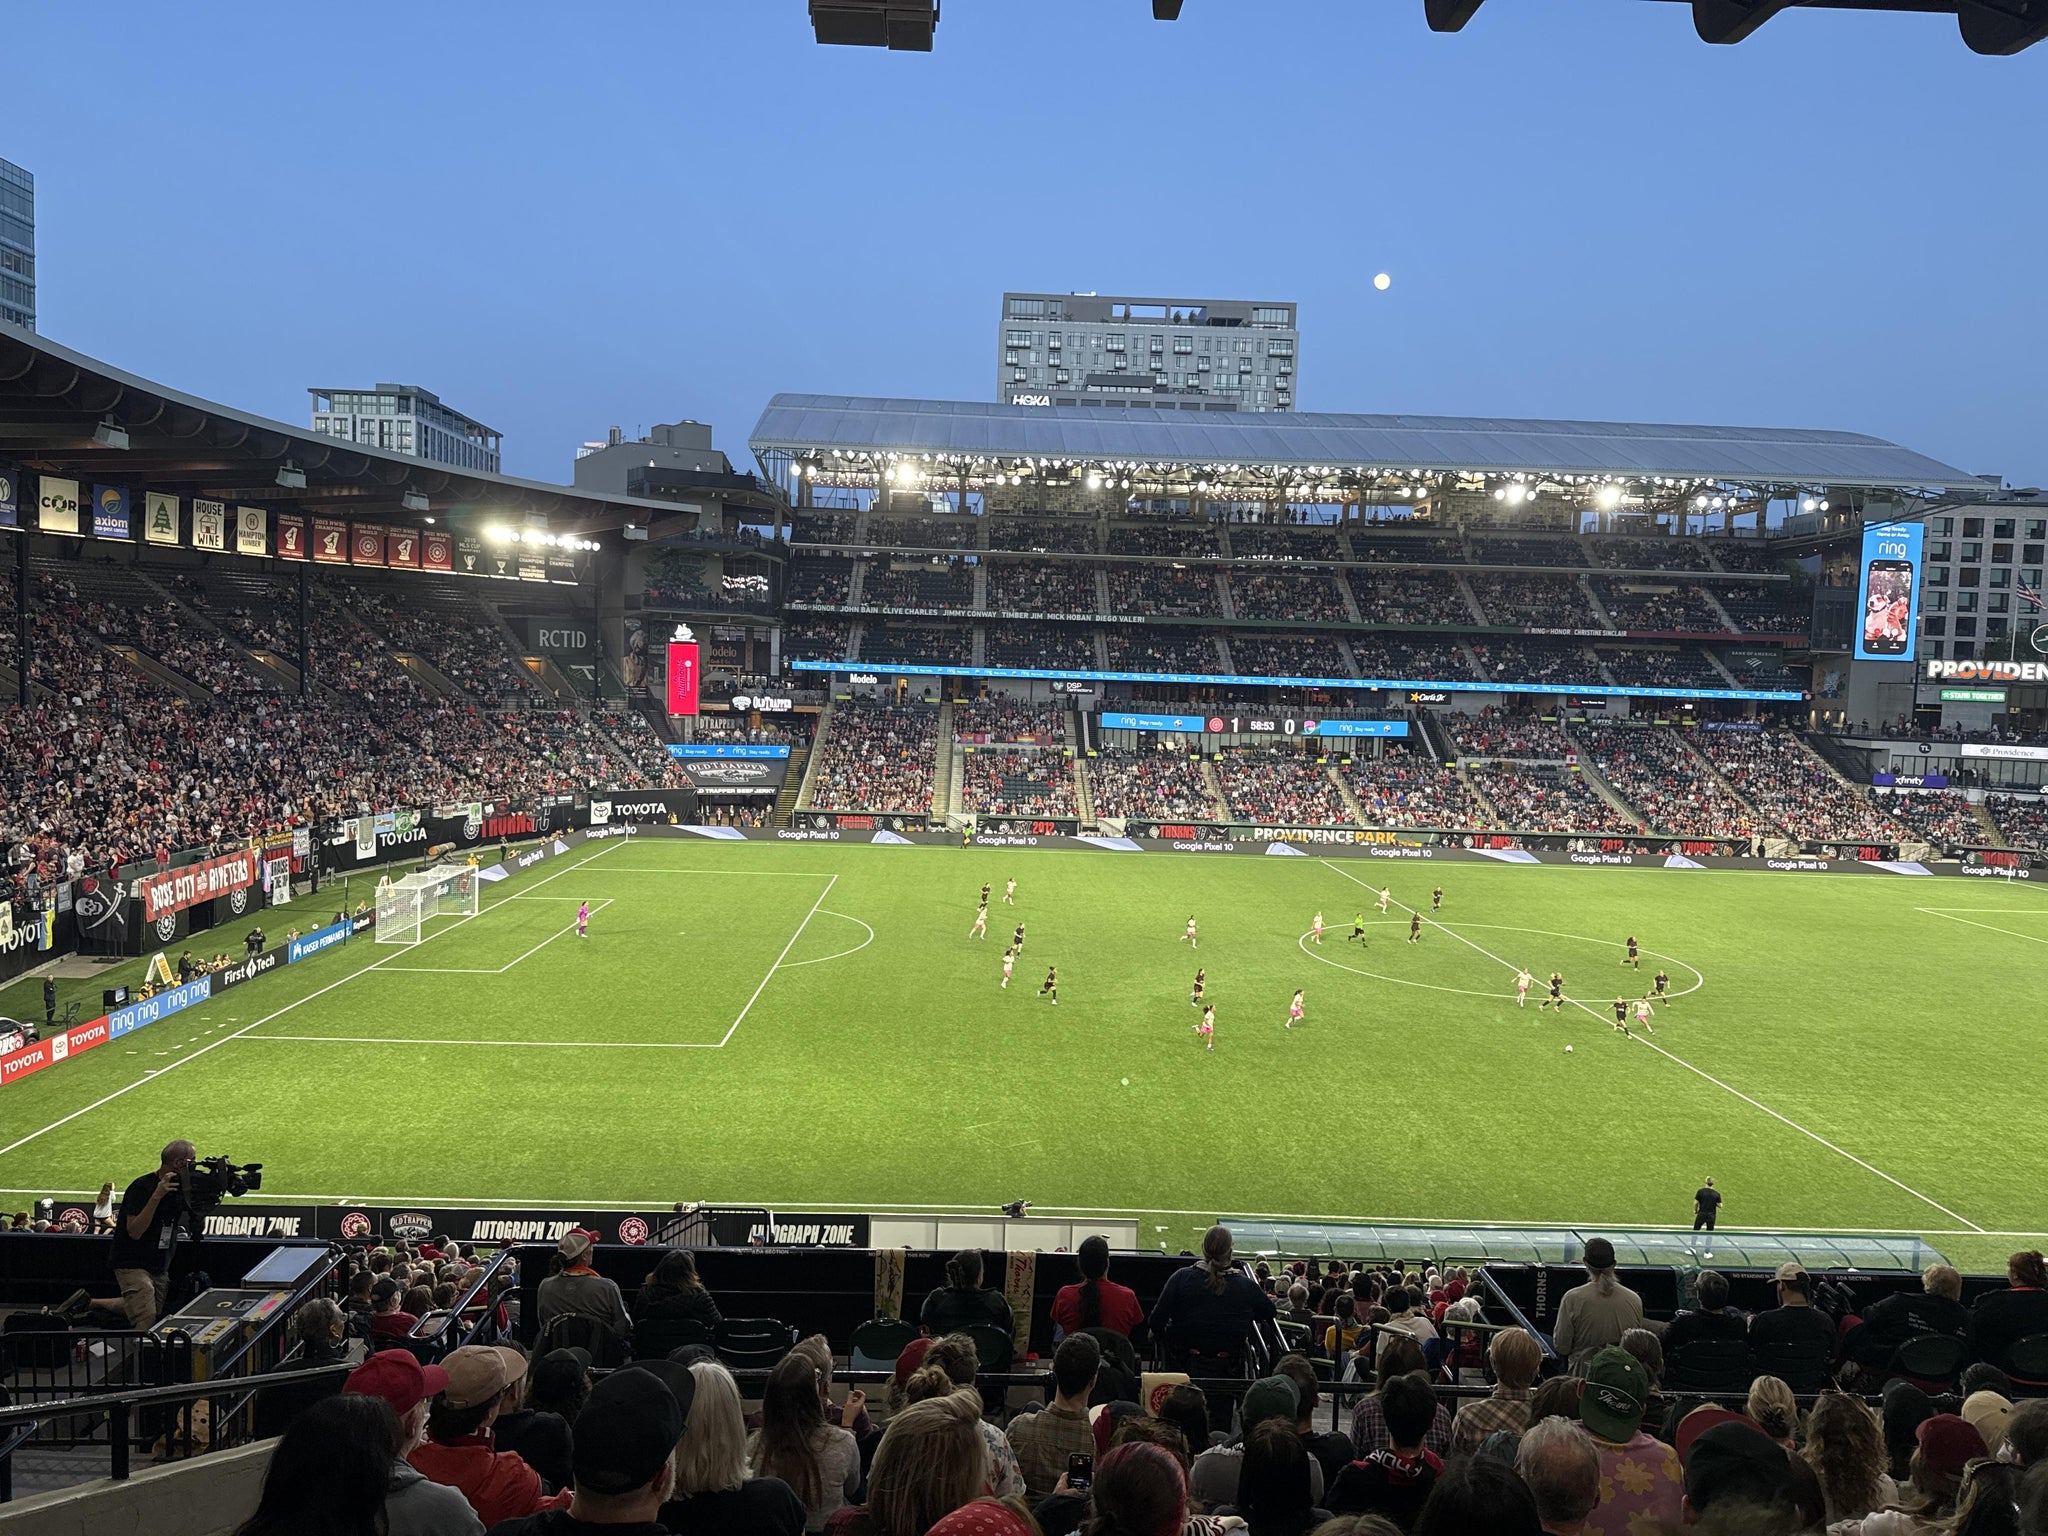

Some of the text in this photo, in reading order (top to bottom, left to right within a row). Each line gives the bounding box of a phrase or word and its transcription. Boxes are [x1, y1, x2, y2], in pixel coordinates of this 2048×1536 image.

[1012, 394, 1050, 406] HOKA
[196, 501, 223, 516] HOUSE
[95, 516, 128, 528] axiom
[198, 533, 220, 547] WINE
[239, 530, 265, 540] HAMPTON
[242, 539, 261, 547] LUMBER
[1879, 541, 1906, 559] ring
[812, 604, 835, 612] HONOR
[861, 606, 878, 614] BAIN
[904, 608, 938, 616] CHARLES
[1002, 611, 1028, 619] TIMBER
[1047, 613, 1065, 621] MICK
[1531, 627, 1545, 635] RING
[539, 629, 587, 648] RCTID
[710, 645, 737, 658] odelo
[850, 673, 878, 684] Modelo
[1121, 717, 1136, 727] ring
[1231, 717, 1239, 732] 1
[1251, 720, 1275, 730] 58:53
[1284, 719, 1295, 734] 0
[1339, 724, 1353, 734] ring
[668, 747, 682, 755] ring
[733, 747, 746, 756] ring
[1993, 747, 2035, 757] Providence
[1895, 775, 1925, 787] xfinity
[615, 803, 667, 816] TOYOTA
[586, 827, 609, 838] Google
[777, 830, 839, 840] Google Pixel 10
[1032, 821, 1055, 835] 2012
[1160, 825, 1196, 839] THORNS
[1254, 827, 1397, 843] PROVIDENCE PARK
[380, 828, 427, 847] TOYOTA
[976, 836, 1037, 846] Google Pixel 10
[1474, 835, 1510, 850] TRNS
[1173, 841, 1234, 851] Google Pixel 10
[1371, 847, 1432, 858] Google Pixel 10
[1601, 839, 1624, 852] 2012
[1570, 854, 1632, 865] Google Pixel 10
[1859, 845, 1881, 861] 2012
[1767, 859, 1828, 871] Google Pixel 10
[1962, 865, 2029, 879] Google Pixel 10
[209, 859, 248, 892] RIVETERS
[151, 881, 175, 912] ROSE
[175, 874, 195, 902] CITY
[3, 921, 42, 954] OYOT
[303, 940, 319, 955] KAISER
[224, 954, 275, 985] First Tech
[112, 979, 209, 1032] ring ring ring ring
[70, 1025, 106, 1047] TOYOTA
[4, 1050, 44, 1074] TOYOTA
[202, 1215, 301, 1236] TOGRAPH ZONE
[472, 1220, 546, 1240] AUTOGRAPH
[821, 1224, 855, 1244] ZONE
[1536, 1270, 1547, 1318] THORNS
